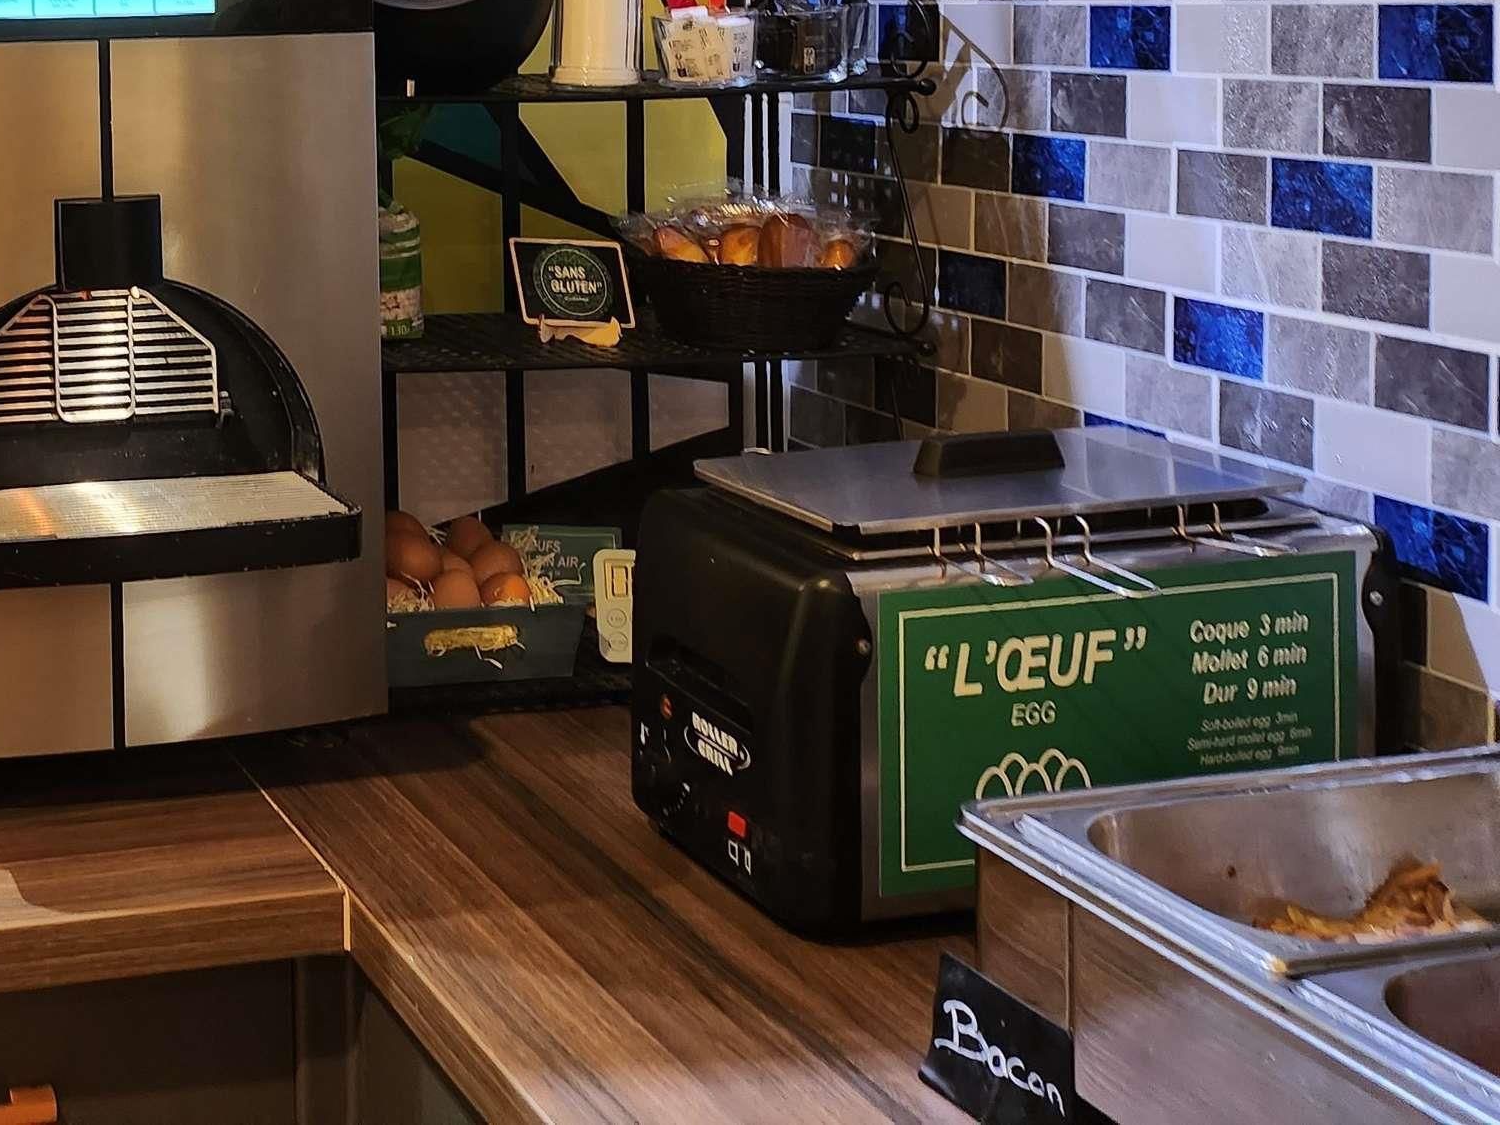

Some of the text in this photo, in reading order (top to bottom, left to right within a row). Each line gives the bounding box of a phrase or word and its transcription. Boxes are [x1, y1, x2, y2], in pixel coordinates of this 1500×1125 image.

[557, 556, 580, 569] AIR
[1189, 610, 1309, 645] Coque 3 min
[1191, 642, 1307, 674] Mollet 6 min
[1203, 674, 1297, 705] Dur 9 min
[1011, 700, 1057, 726] EGG
[1253, 716, 1271, 728] egg
[692, 711, 739, 757] ROLLER
[697, 738, 734, 776] GRILL
[933, 999, 1066, 1117] Bacon
